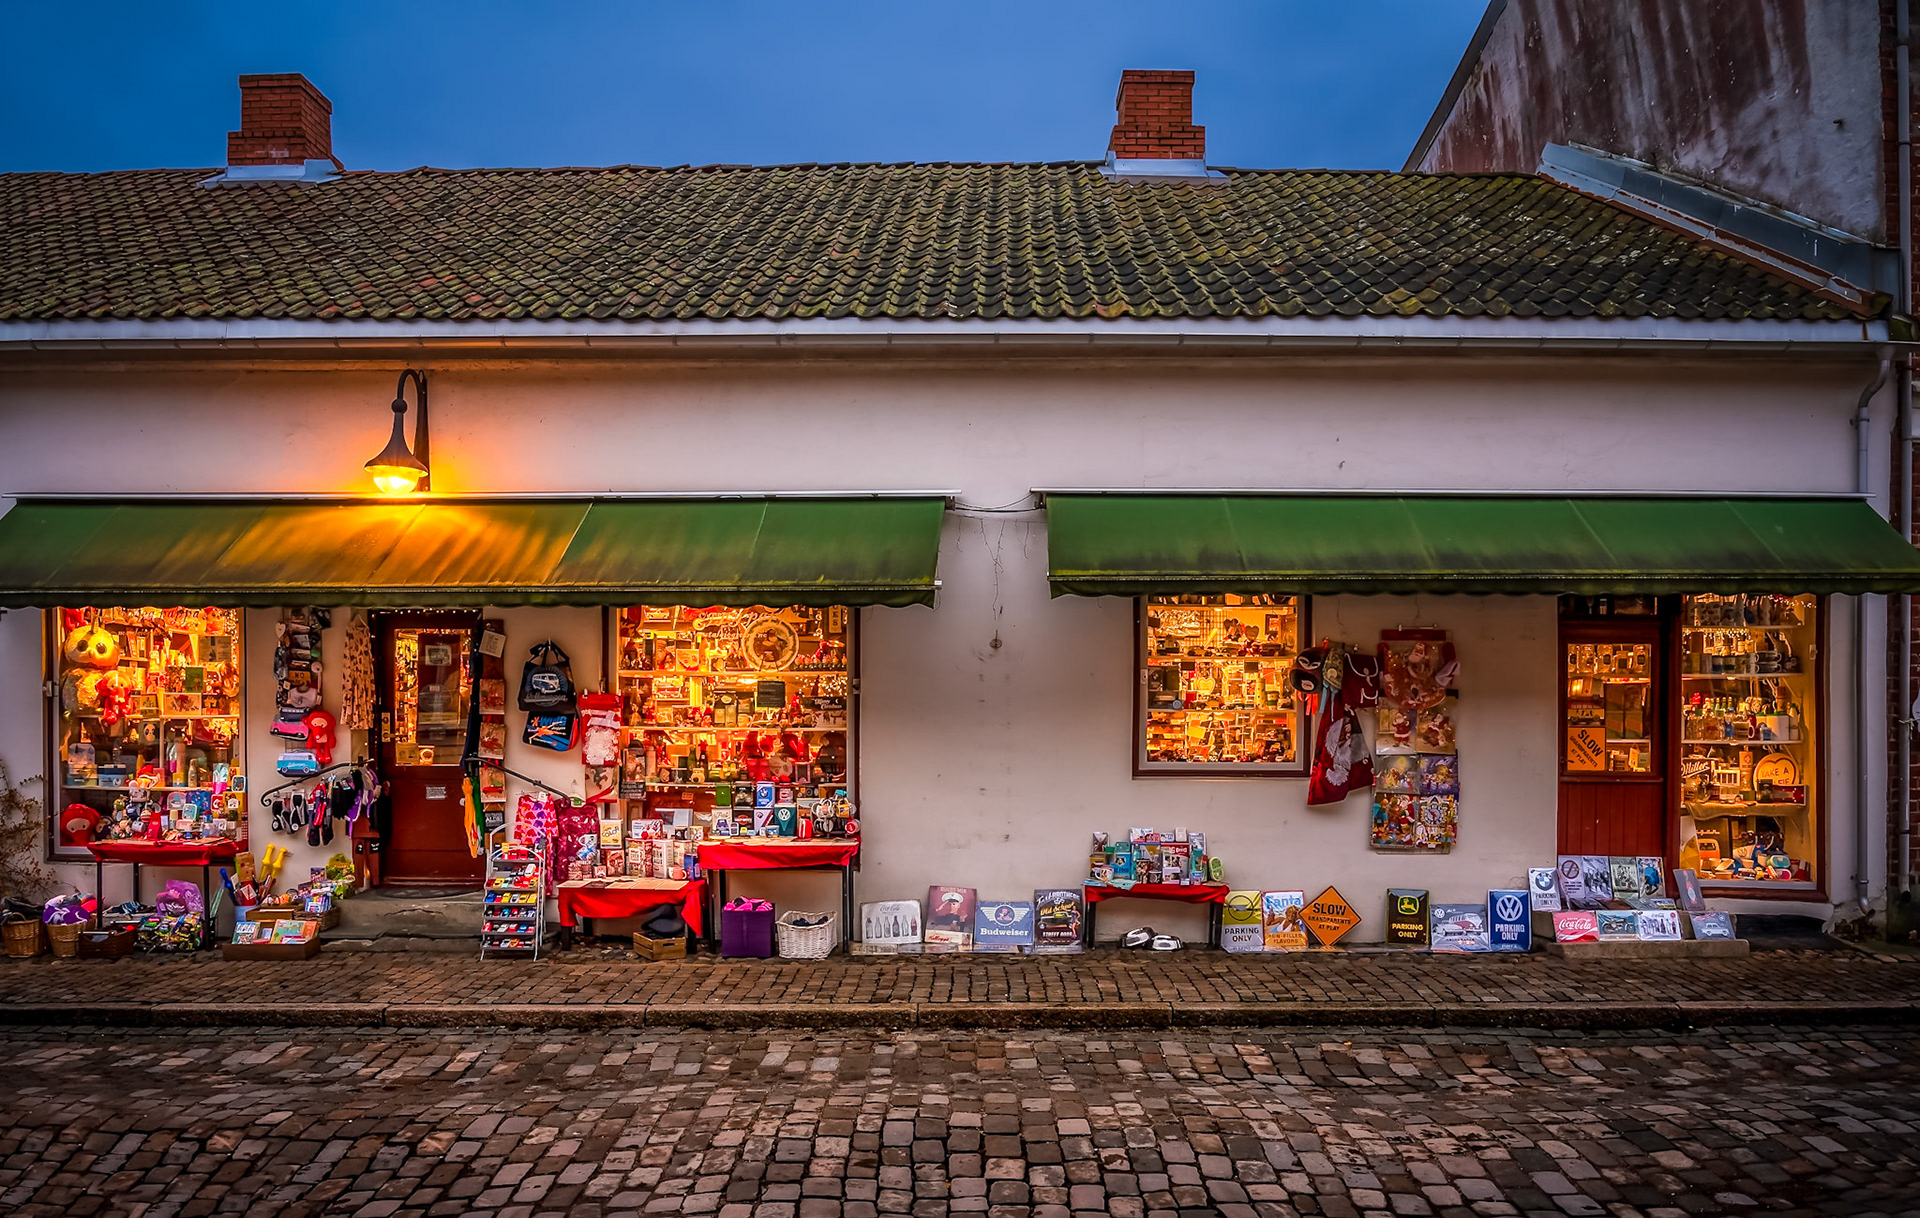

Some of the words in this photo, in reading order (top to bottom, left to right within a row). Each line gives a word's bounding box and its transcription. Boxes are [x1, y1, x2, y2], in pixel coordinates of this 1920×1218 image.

[1577, 729, 1604, 757] SLOW
[1265, 894, 1303, 909] Fanta
[1312, 902, 1347, 916] SLOW
[1308, 915, 1351, 925] GRANDPARENTS
[1224, 926, 1260, 935] PARKING
[1391, 922, 1424, 931] PARKING
[1495, 923, 1526, 933] PARKING
[980, 927, 1029, 936] Budweiser
[1232, 935, 1252, 943] ONLY
[1501, 932, 1519, 941] ONLY
